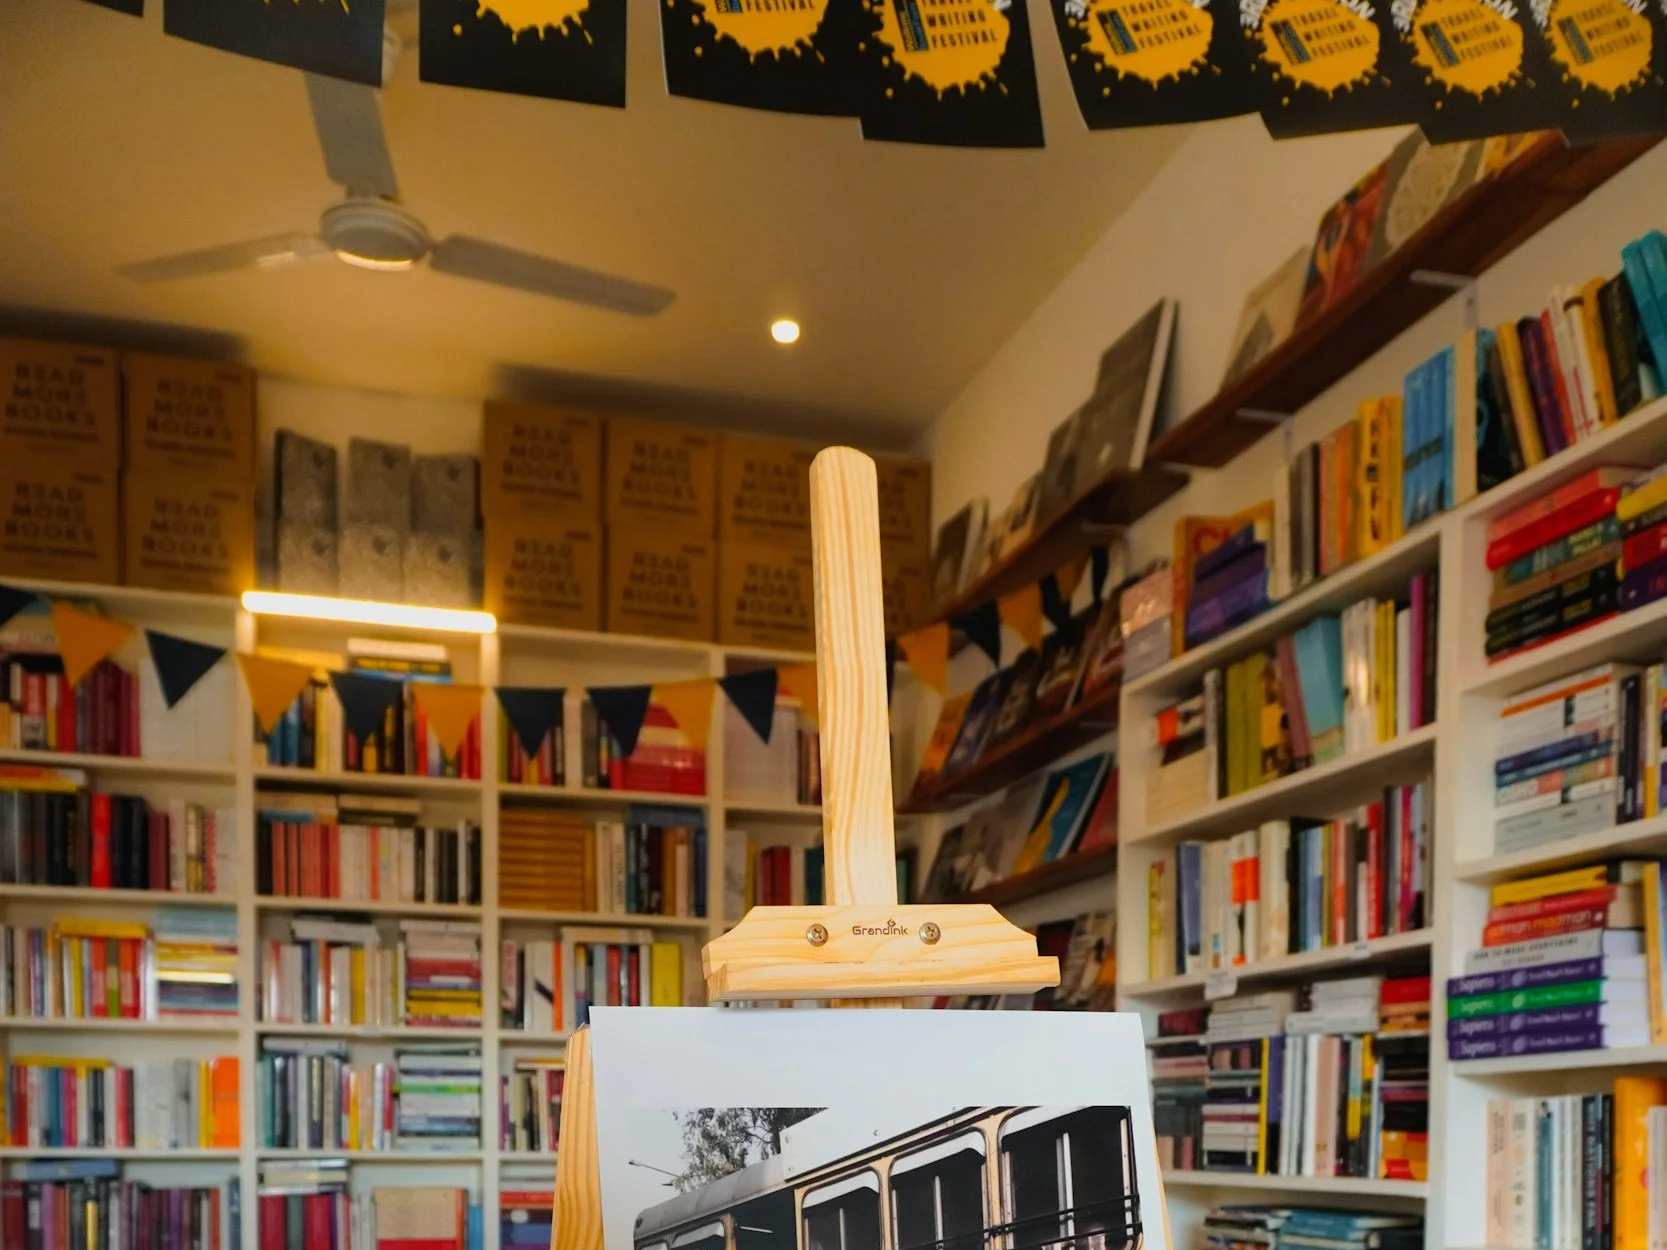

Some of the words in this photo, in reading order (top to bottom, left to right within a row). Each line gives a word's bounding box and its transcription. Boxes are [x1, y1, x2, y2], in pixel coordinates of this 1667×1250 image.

[926, 9, 987, 28] WRITING
[931, 29, 997, 49] FESTIVAL
[852, 919, 908, 936] Grandink
